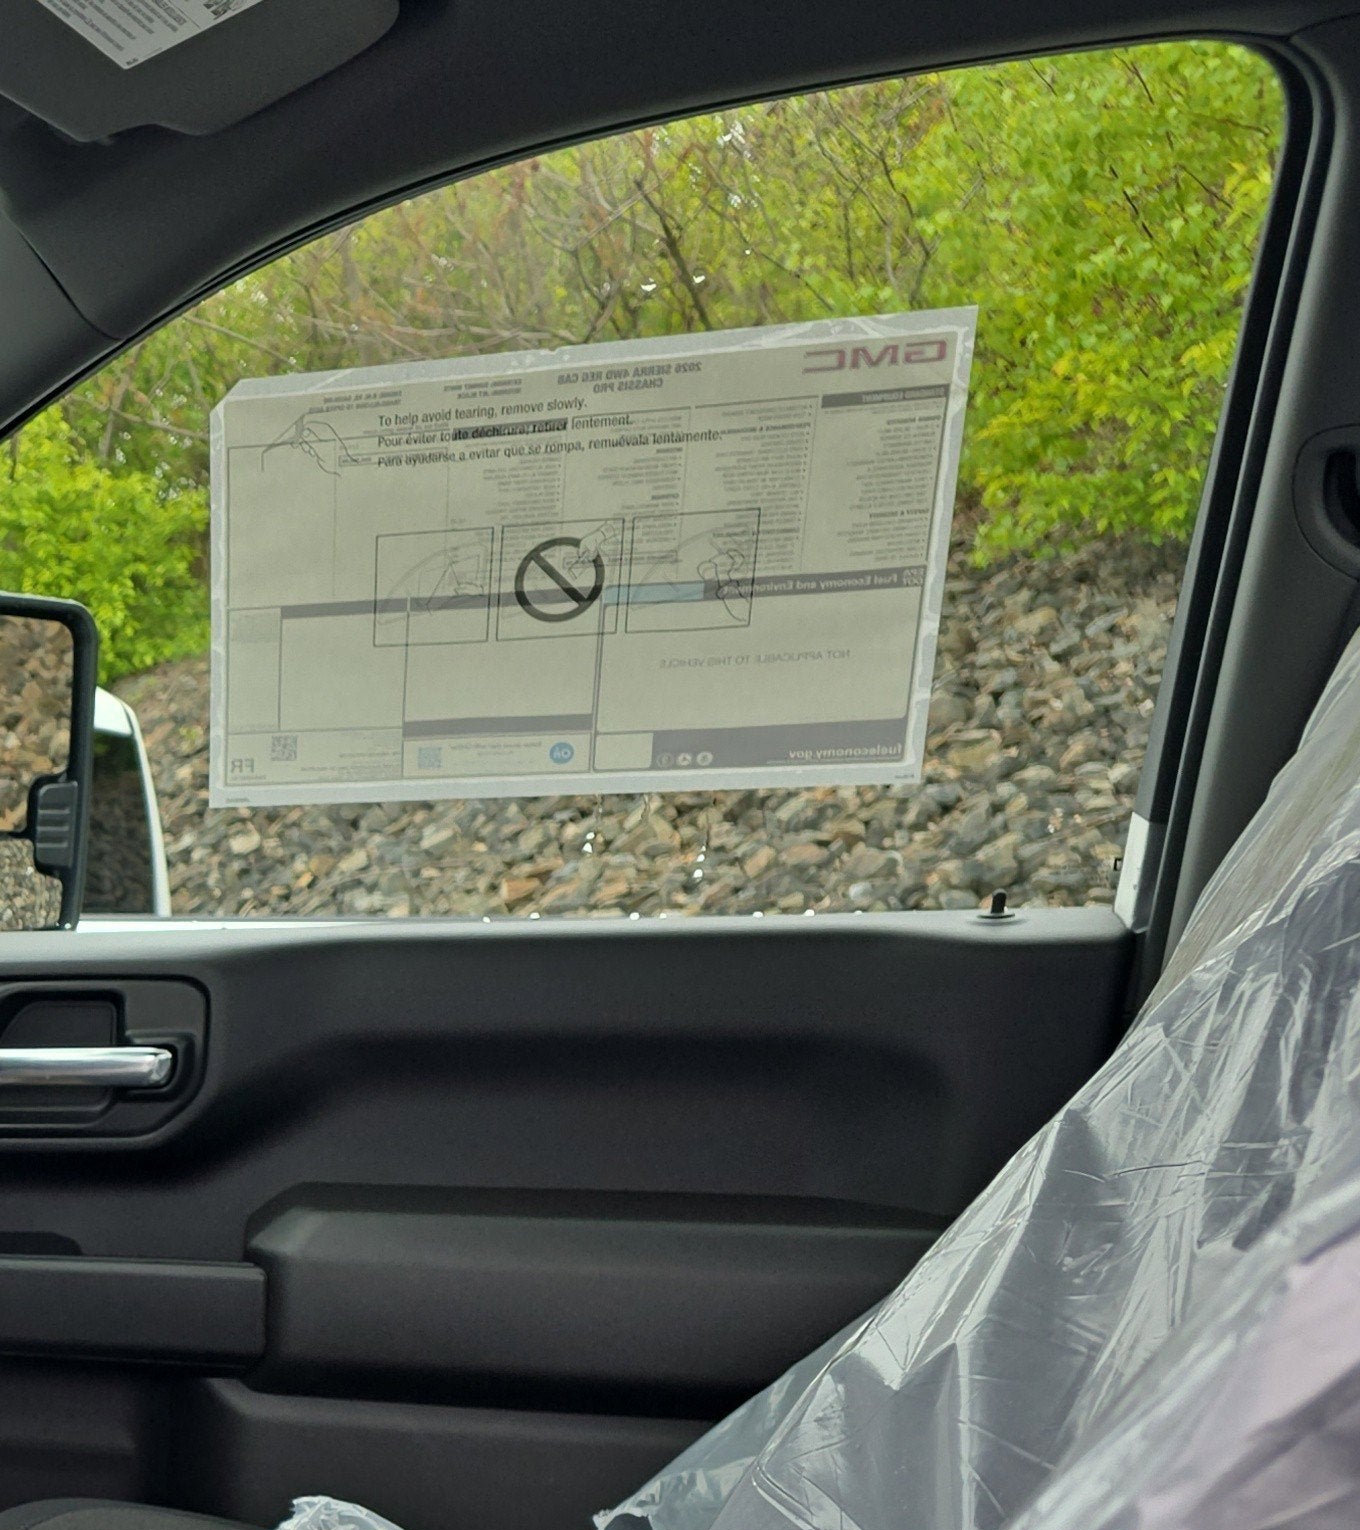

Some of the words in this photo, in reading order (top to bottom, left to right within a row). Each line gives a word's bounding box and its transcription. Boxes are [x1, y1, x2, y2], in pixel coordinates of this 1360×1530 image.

[379, 414, 391, 427] To
[395, 411, 418, 426] help
[422, 408, 452, 423] avoid
[455, 405, 498, 420] tearing,
[501, 403, 544, 416] remove
[547, 396, 588, 411] slowly.
[378, 435, 402, 448] Pour
[378, 454, 402, 467] Para
[459, 451, 466, 461] a
[469, 446, 500, 460] evitar
[504, 444, 524, 458] que
[528, 444, 541, 455] se
